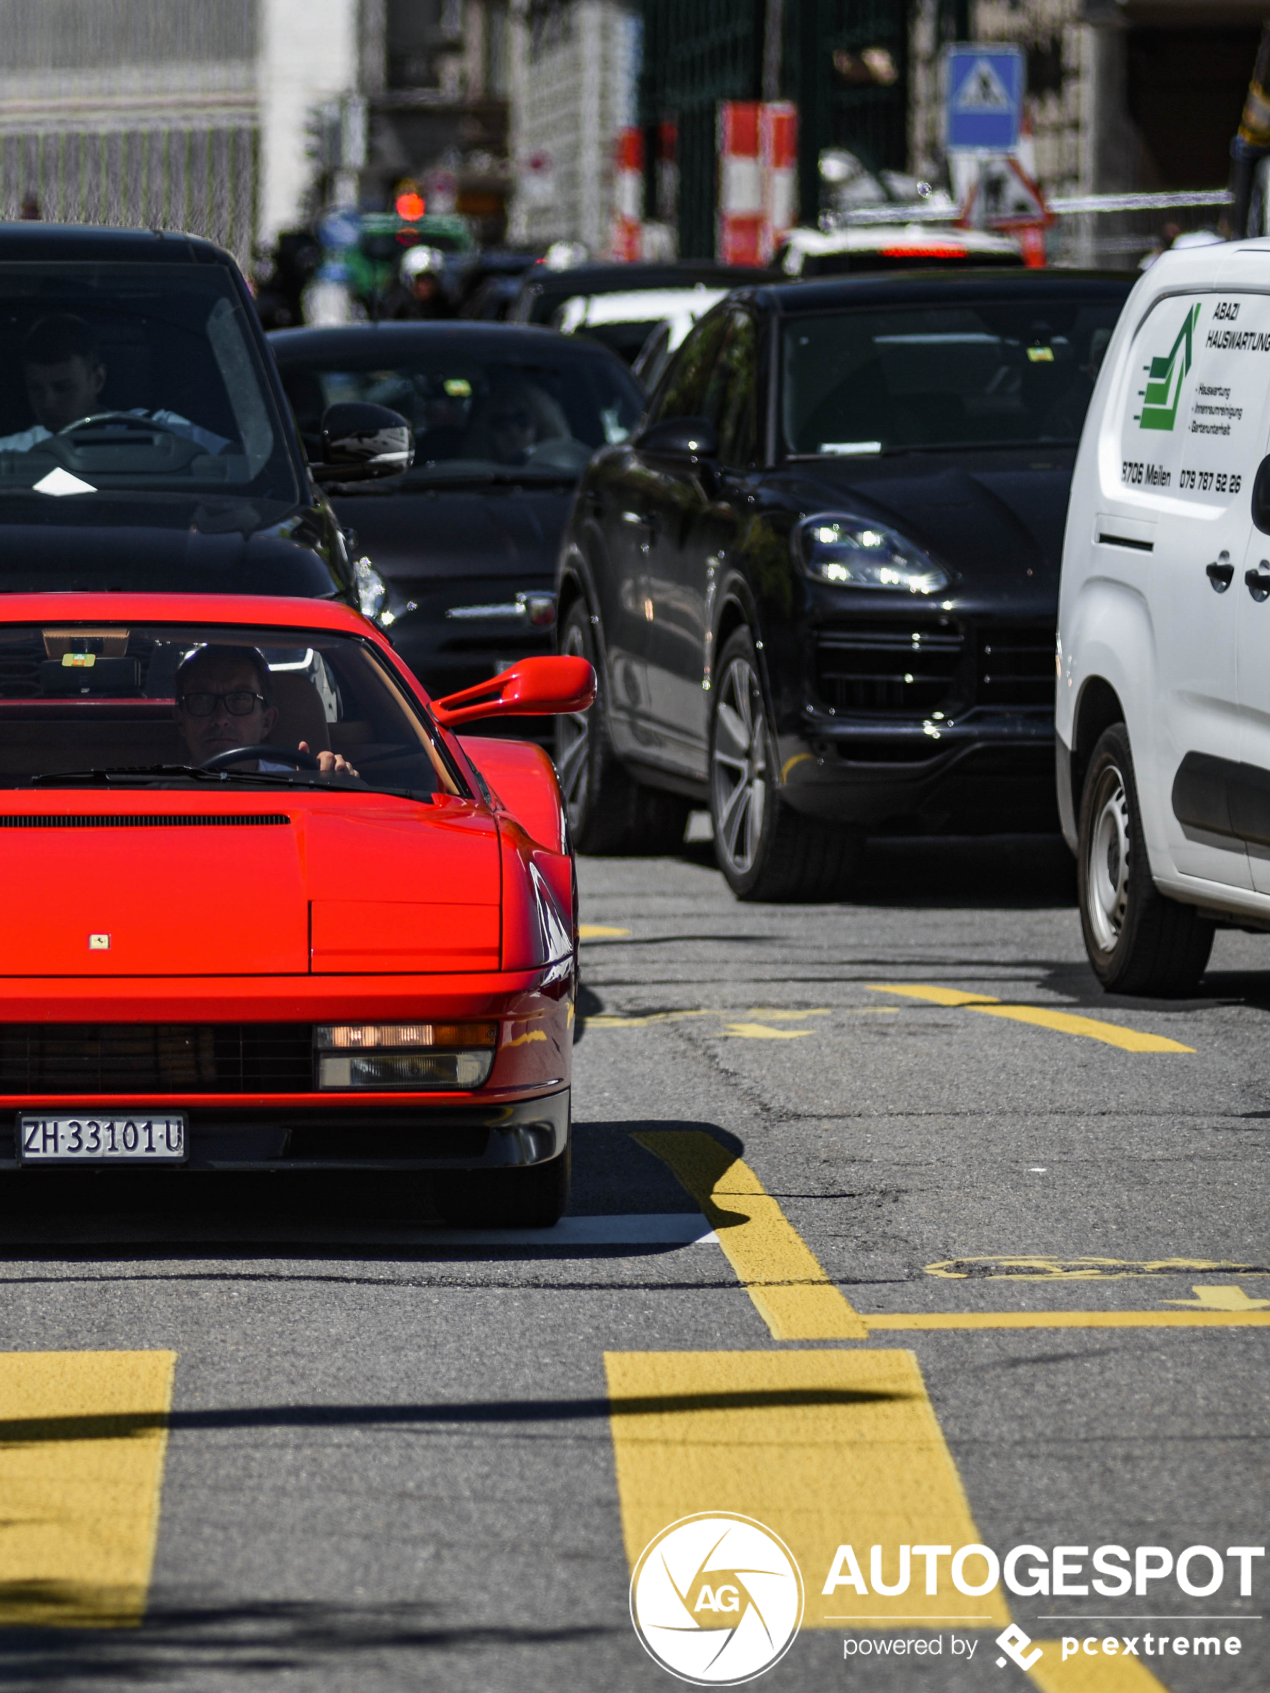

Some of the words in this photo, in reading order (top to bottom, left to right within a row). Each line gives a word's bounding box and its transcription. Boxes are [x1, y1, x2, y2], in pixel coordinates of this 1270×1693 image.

[1213, 302, 1241, 321] ABAZI
[1206, 330, 1270, 352] HAUSWARTUNG
[1198, 383, 1231, 400] Hauswartung
[1145, 464, 1171, 487] Meilen
[1179, 469, 1196, 489] 079
[1198, 472, 1214, 491] 787
[1215, 473, 1228, 492] 52
[1229, 474, 1242, 494] 26
